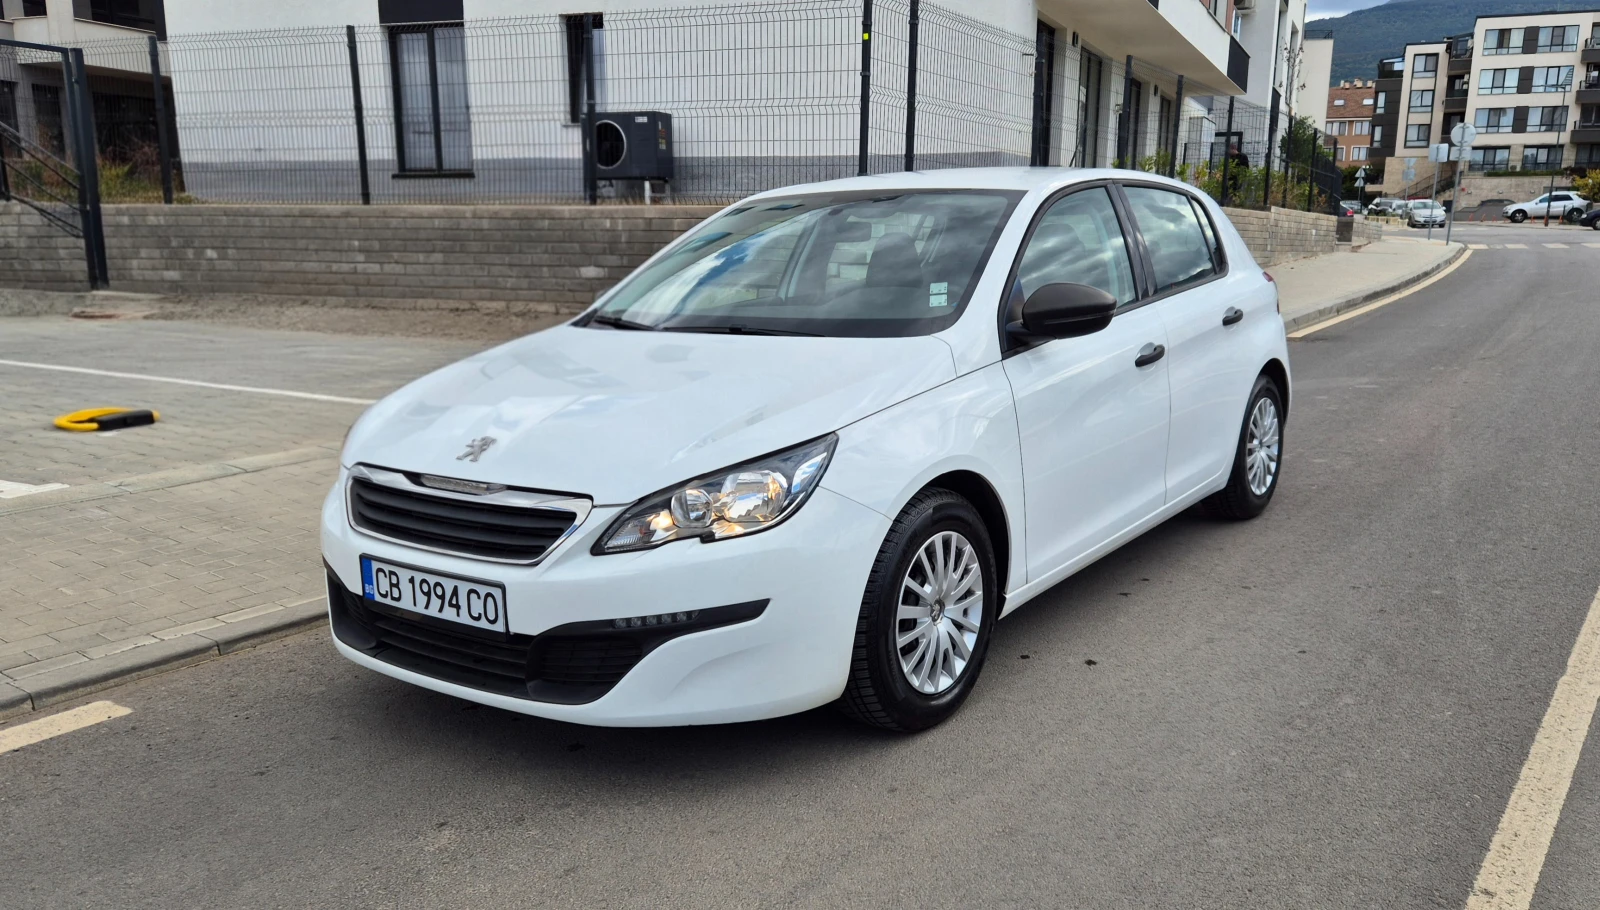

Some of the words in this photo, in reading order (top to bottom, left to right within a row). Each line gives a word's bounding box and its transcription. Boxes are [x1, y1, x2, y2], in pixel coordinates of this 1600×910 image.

[375, 567, 402, 602] CB
[408, 575, 461, 618] 1994
[466, 588, 499, 625] CO
